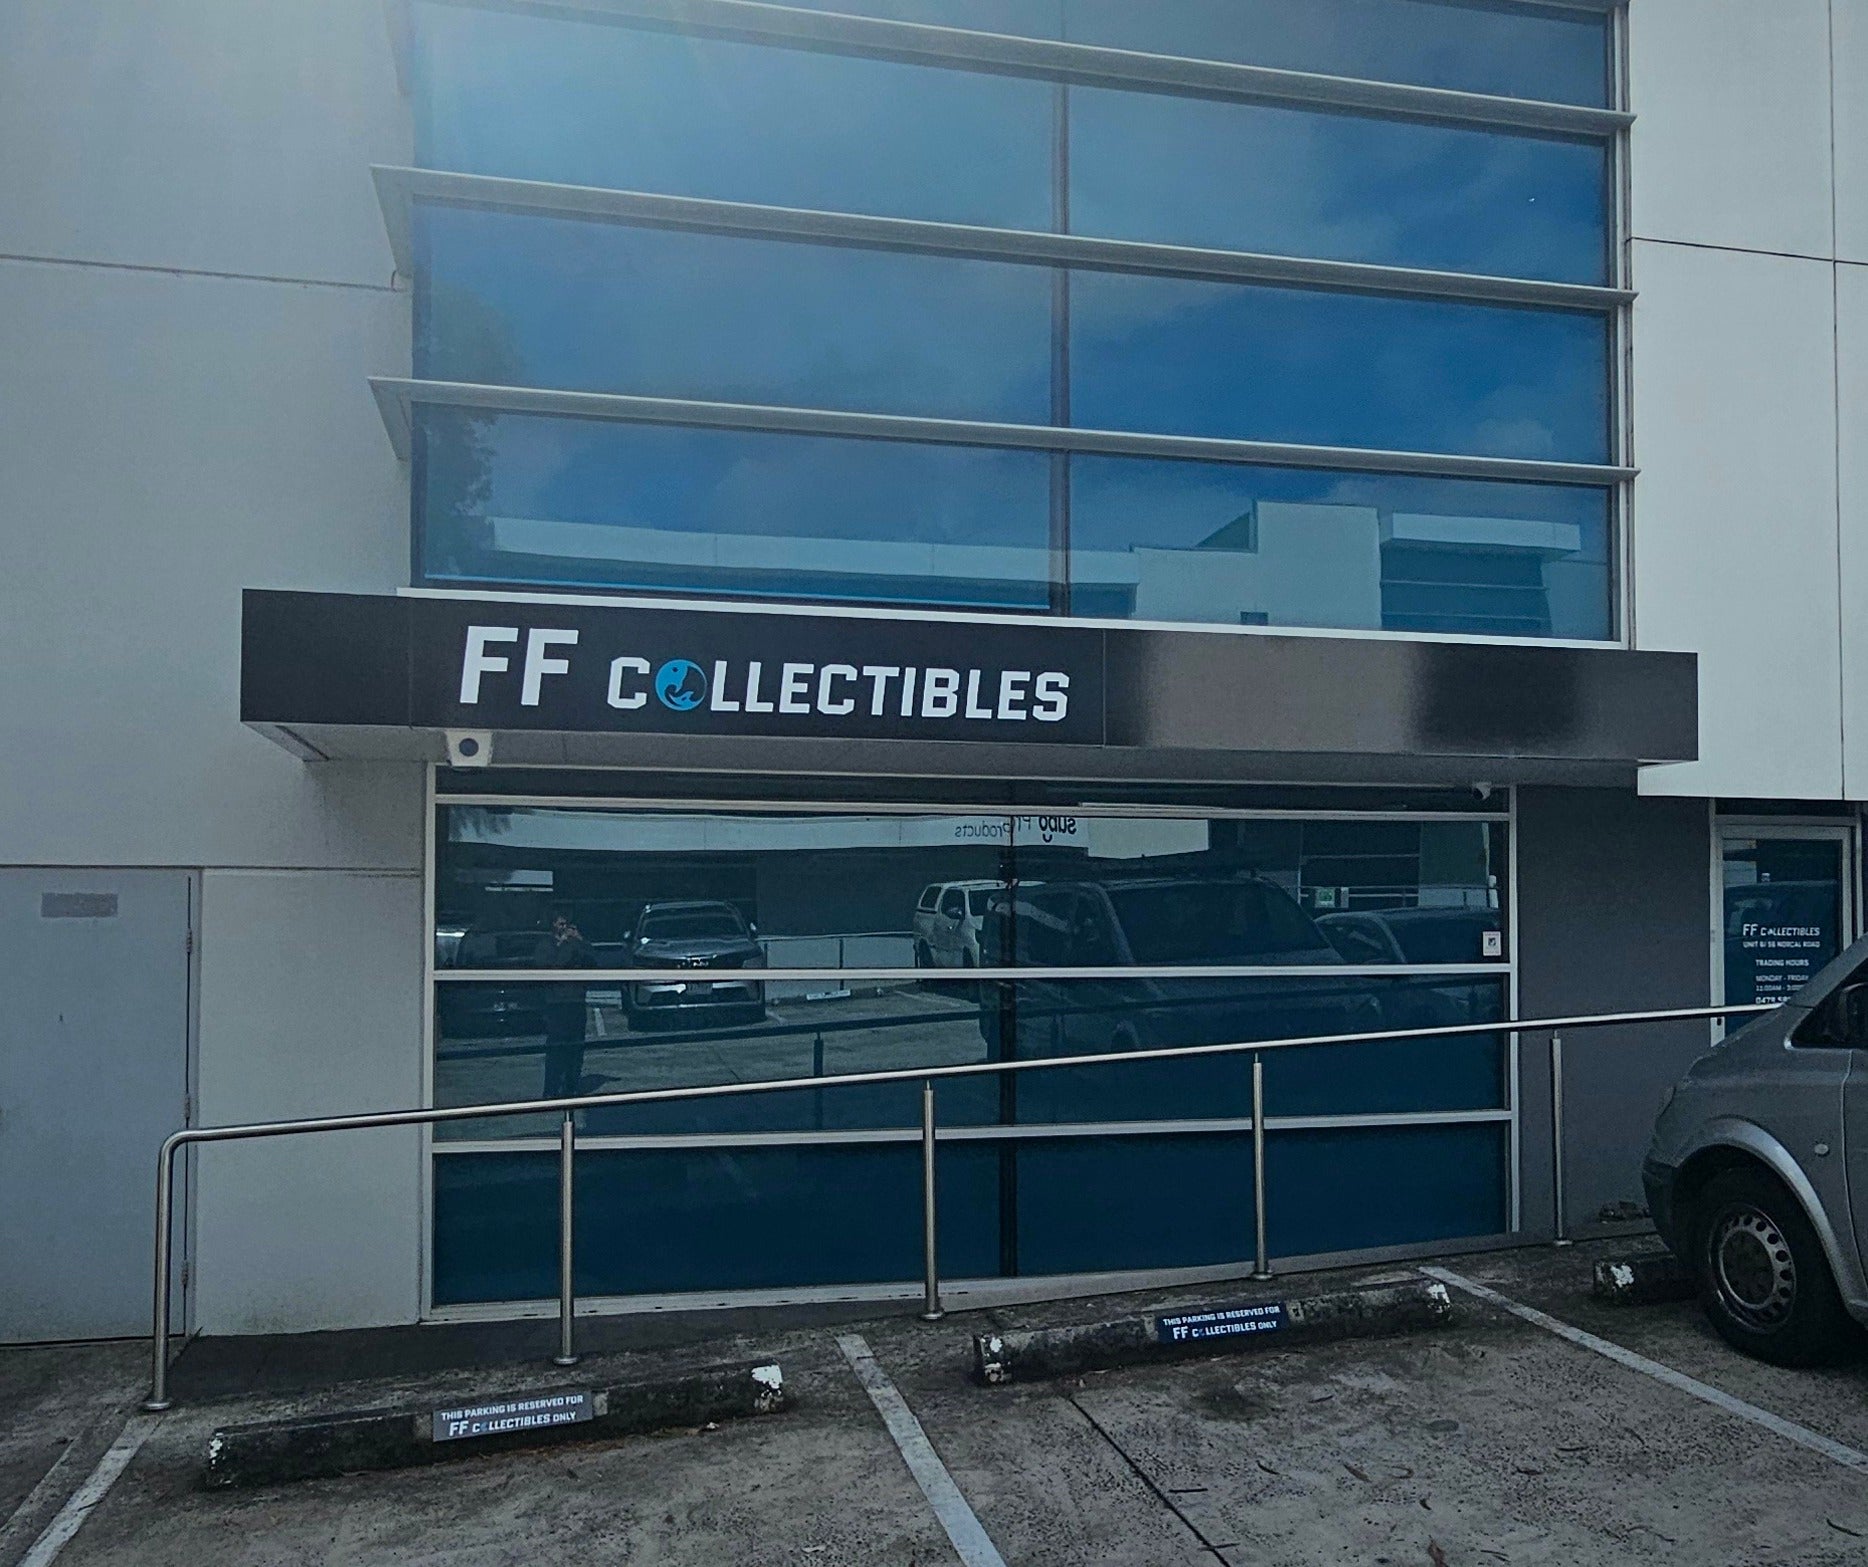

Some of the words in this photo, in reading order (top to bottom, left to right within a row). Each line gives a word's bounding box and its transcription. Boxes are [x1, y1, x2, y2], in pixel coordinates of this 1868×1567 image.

[459, 625, 579, 706] FF
[606, 656, 1071, 722] COLLECTIBLES
[1743, 924, 1758, 936] FF
[1755, 959, 1784, 967] TRADING
[1785, 959, 1809, 967] HOURS
[1163, 1317, 1181, 1326] THIS
[1182, 1313, 1216, 1324] PARKING
[1217, 1312, 1225, 1320] IS
[1226, 1307, 1264, 1319] RESERVED
[1265, 1305, 1280, 1314] FOR
[1173, 1326, 1188, 1340] FF
[1258, 1320, 1277, 1330] ONLY
[441, 1409, 463, 1421] THIS
[464, 1405, 505, 1418] PARKING
[507, 1403, 516, 1412] IS
[518, 1397, 564, 1411] RESERVED
[565, 1395, 584, 1405] FOR
[449, 1421, 469, 1436] FF
[553, 1411, 576, 1423] ONLY
